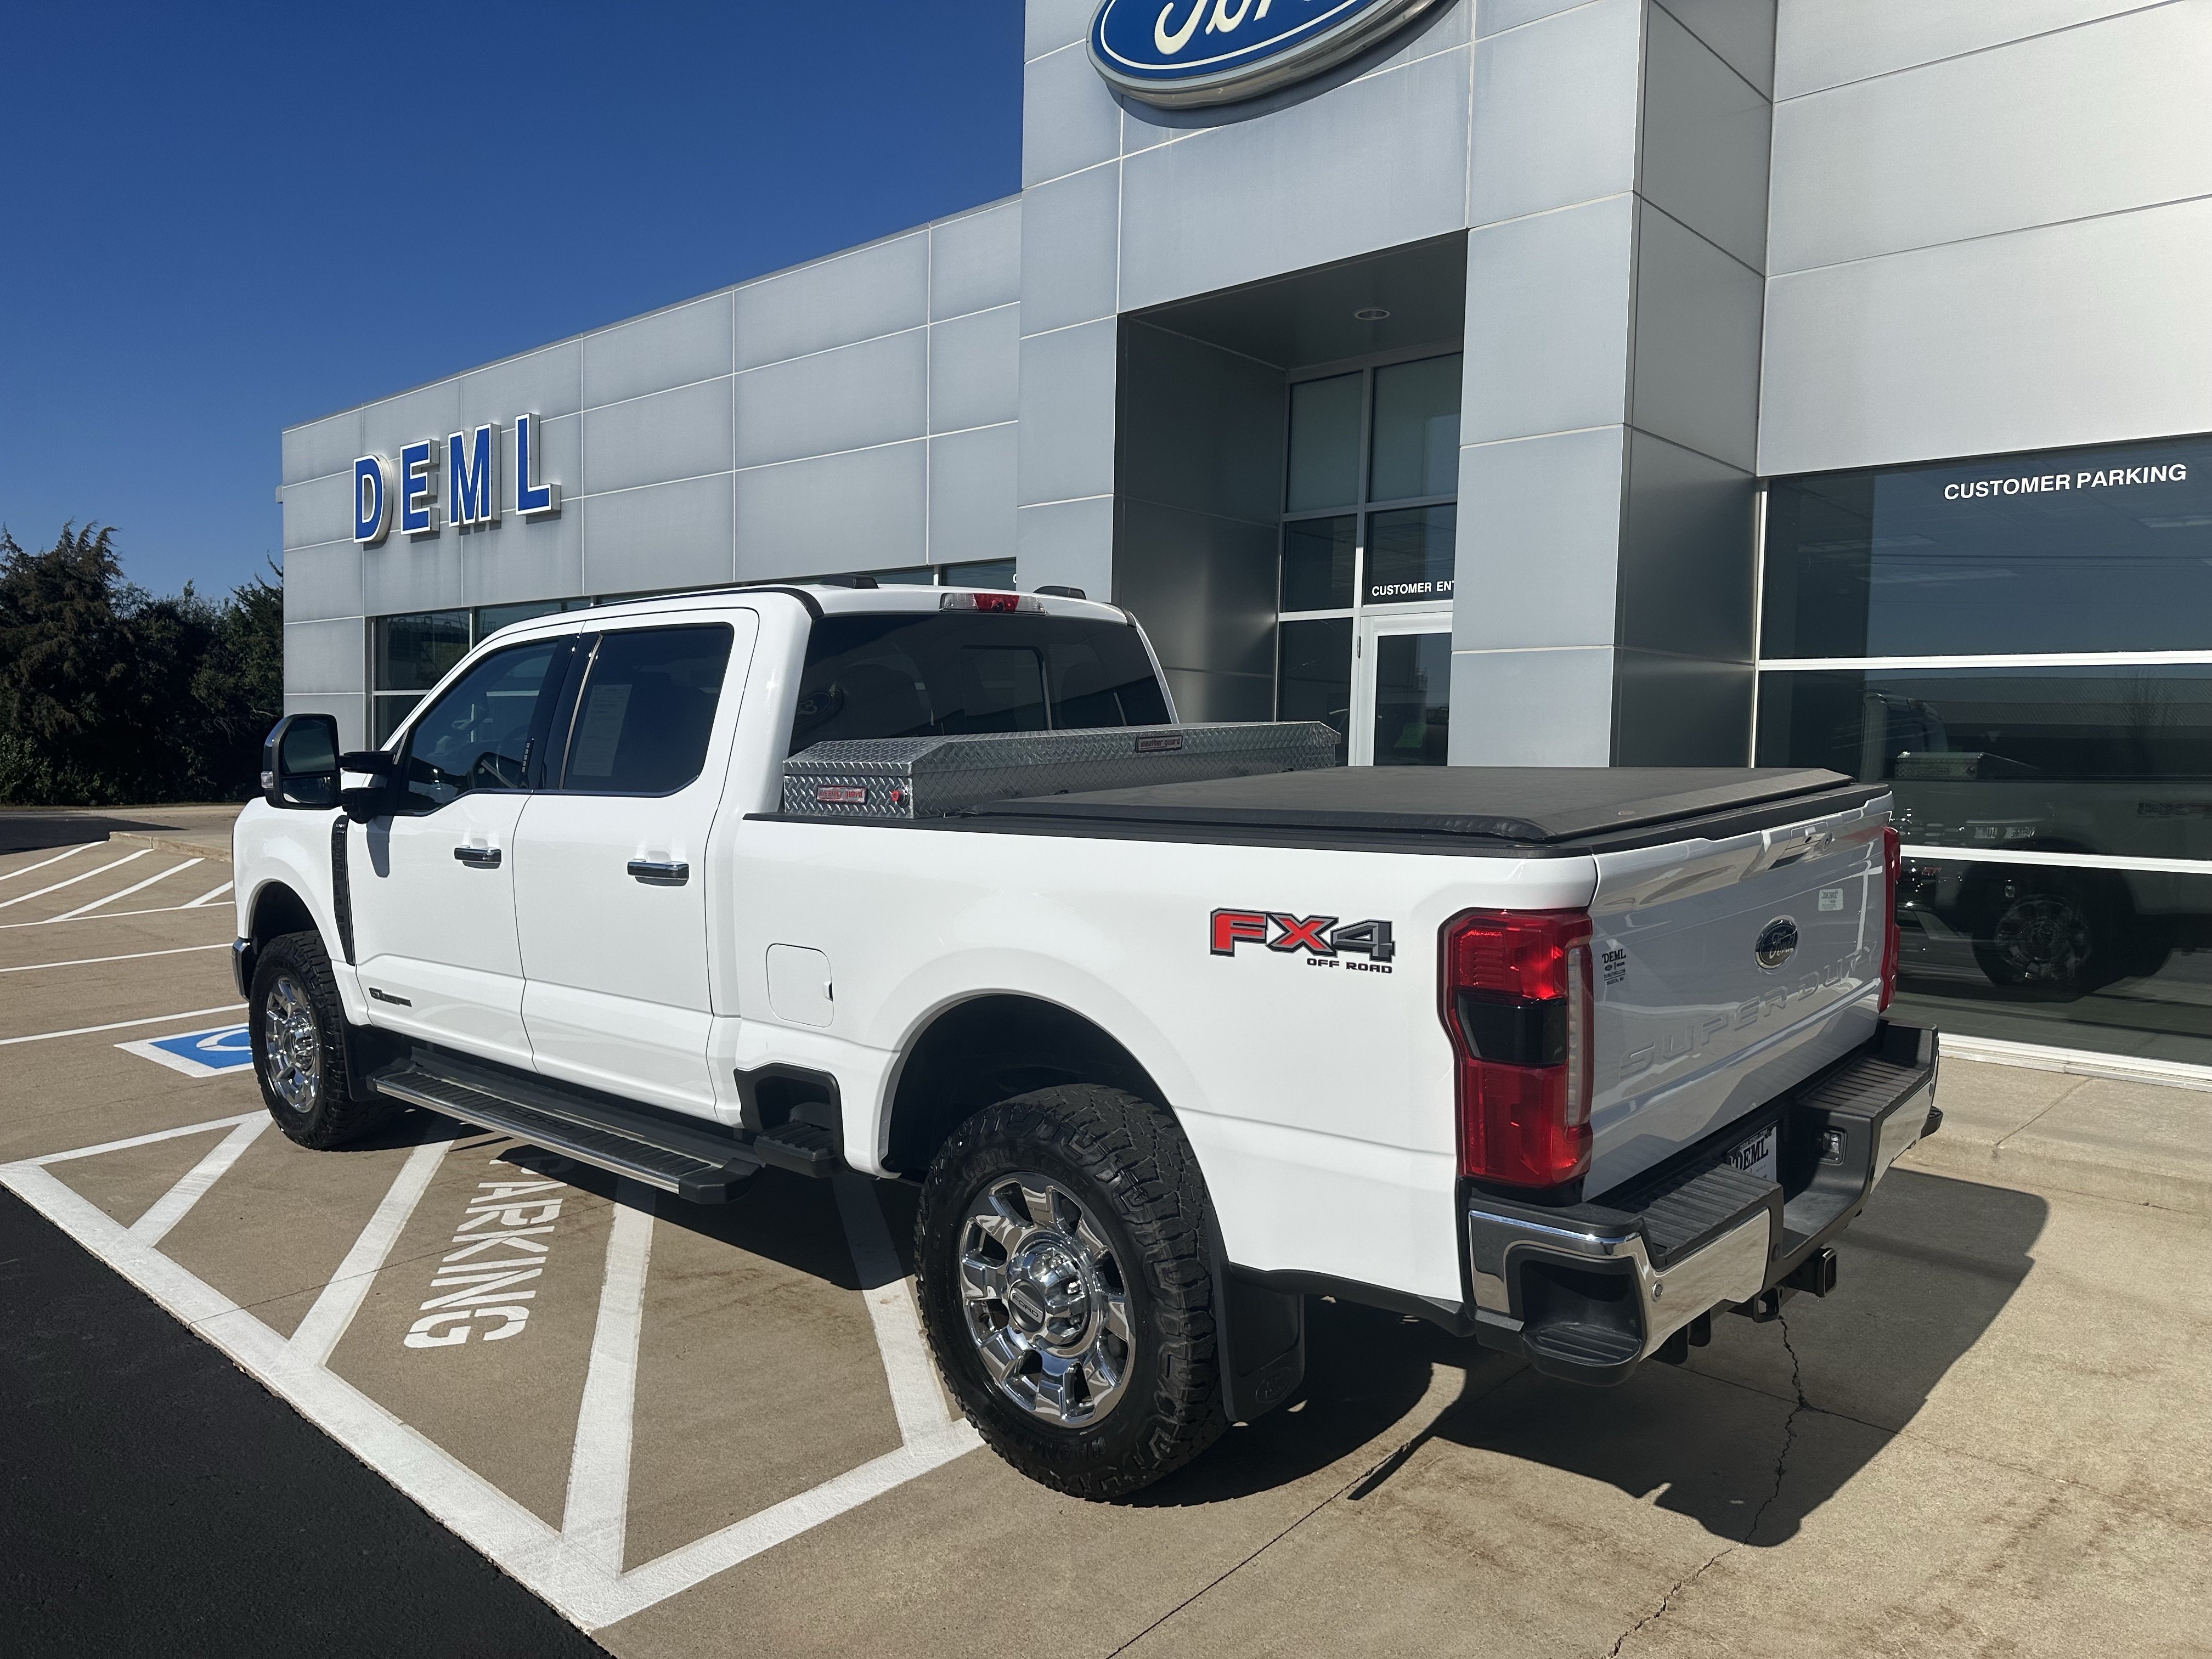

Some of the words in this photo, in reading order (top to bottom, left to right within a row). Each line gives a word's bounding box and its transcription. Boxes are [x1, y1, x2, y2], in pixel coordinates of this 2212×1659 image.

[353, 413, 554, 543] DEML
[1944, 473, 2070, 500] CUSTOMER
[2076, 464, 2187, 488] PARKING
[1372, 582, 1432, 596] CUSTOMER
[1210, 907, 1396, 963] FX4
[1307, 957, 1340, 968] OFF
[1346, 961, 1393, 974] ROAD
[1602, 949, 1626, 964] DEML
[1620, 986, 1787, 1082] SUPER
[1798, 940, 1877, 1002] DUTY
[510, 1109, 575, 1130] FORD
[1013, 1295, 1039, 1317] FORD
